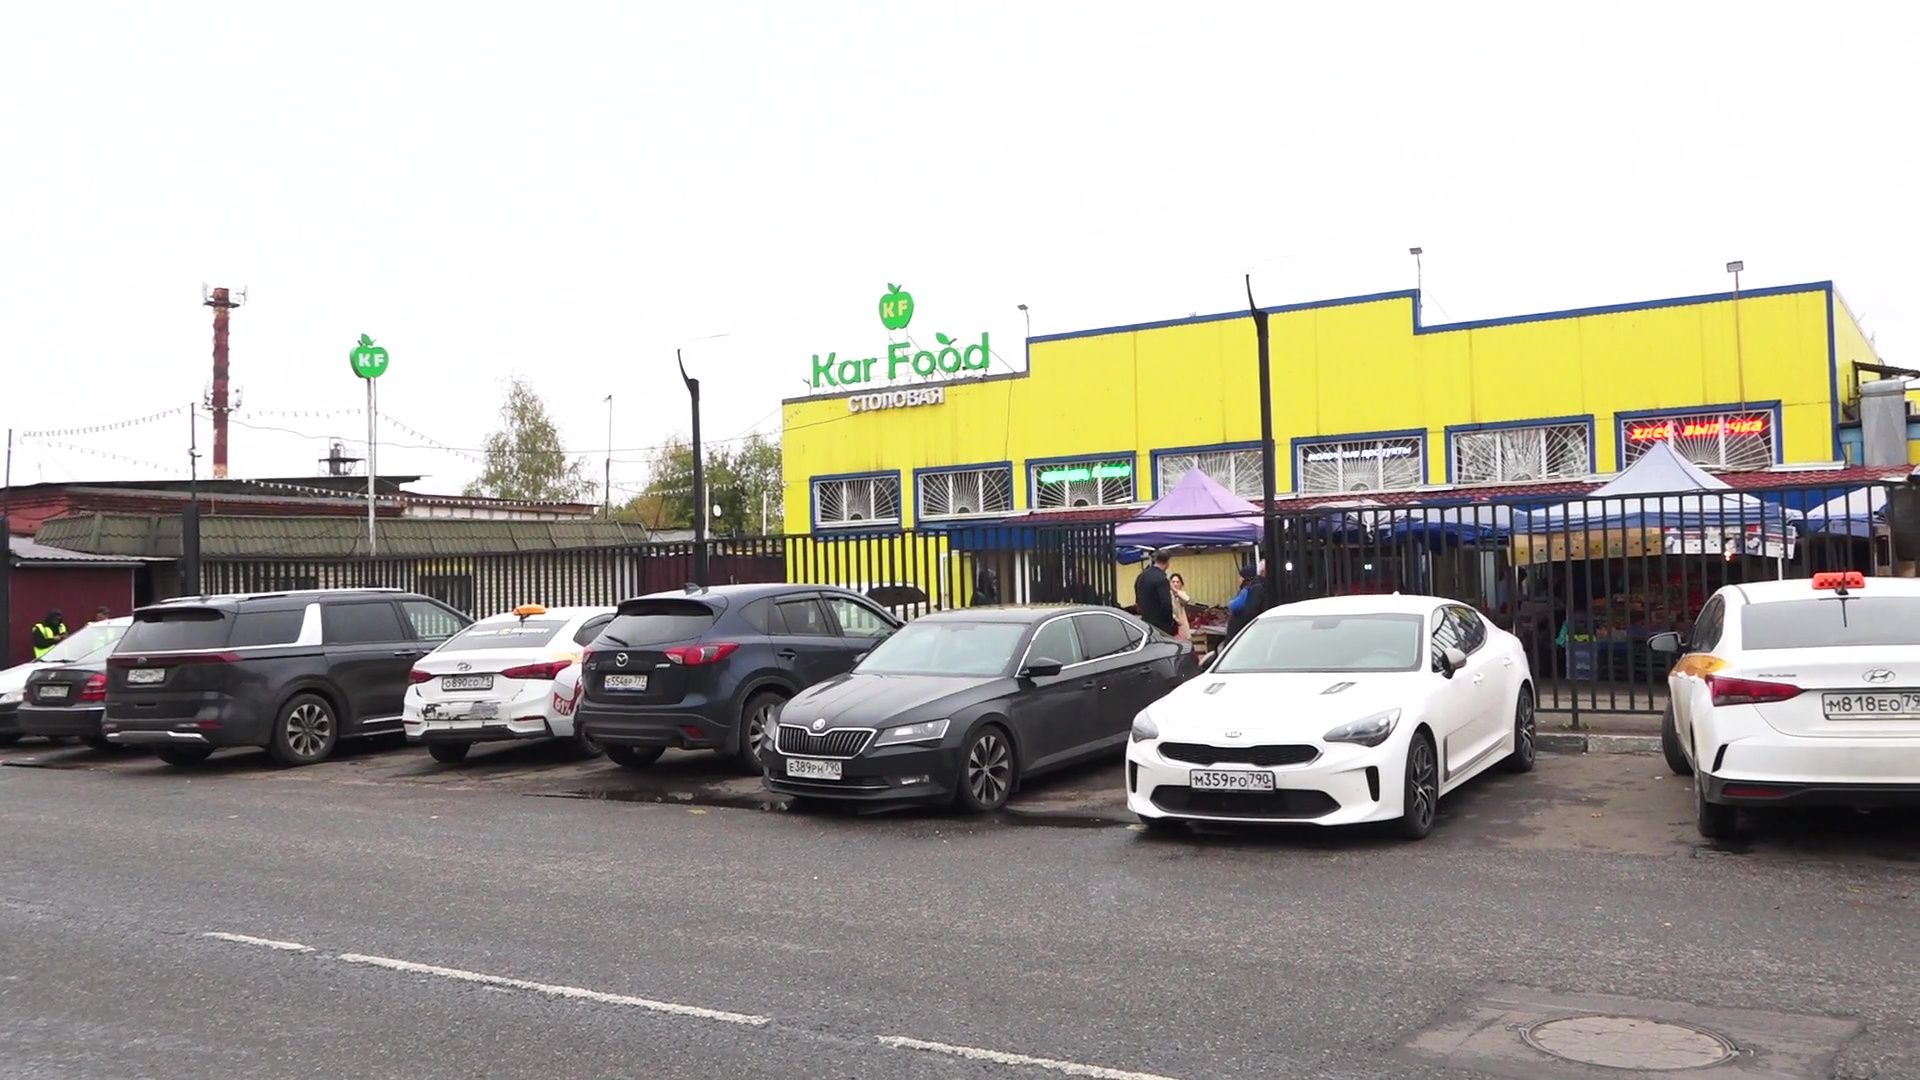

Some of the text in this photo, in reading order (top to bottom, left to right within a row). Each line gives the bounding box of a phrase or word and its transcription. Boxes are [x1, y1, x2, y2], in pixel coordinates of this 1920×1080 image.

[882, 300, 908, 318] KF
[358, 353, 384, 367] KF
[812, 331, 990, 388] Kar Food
[849, 387, 944, 413] СТОЛОВАЯ
